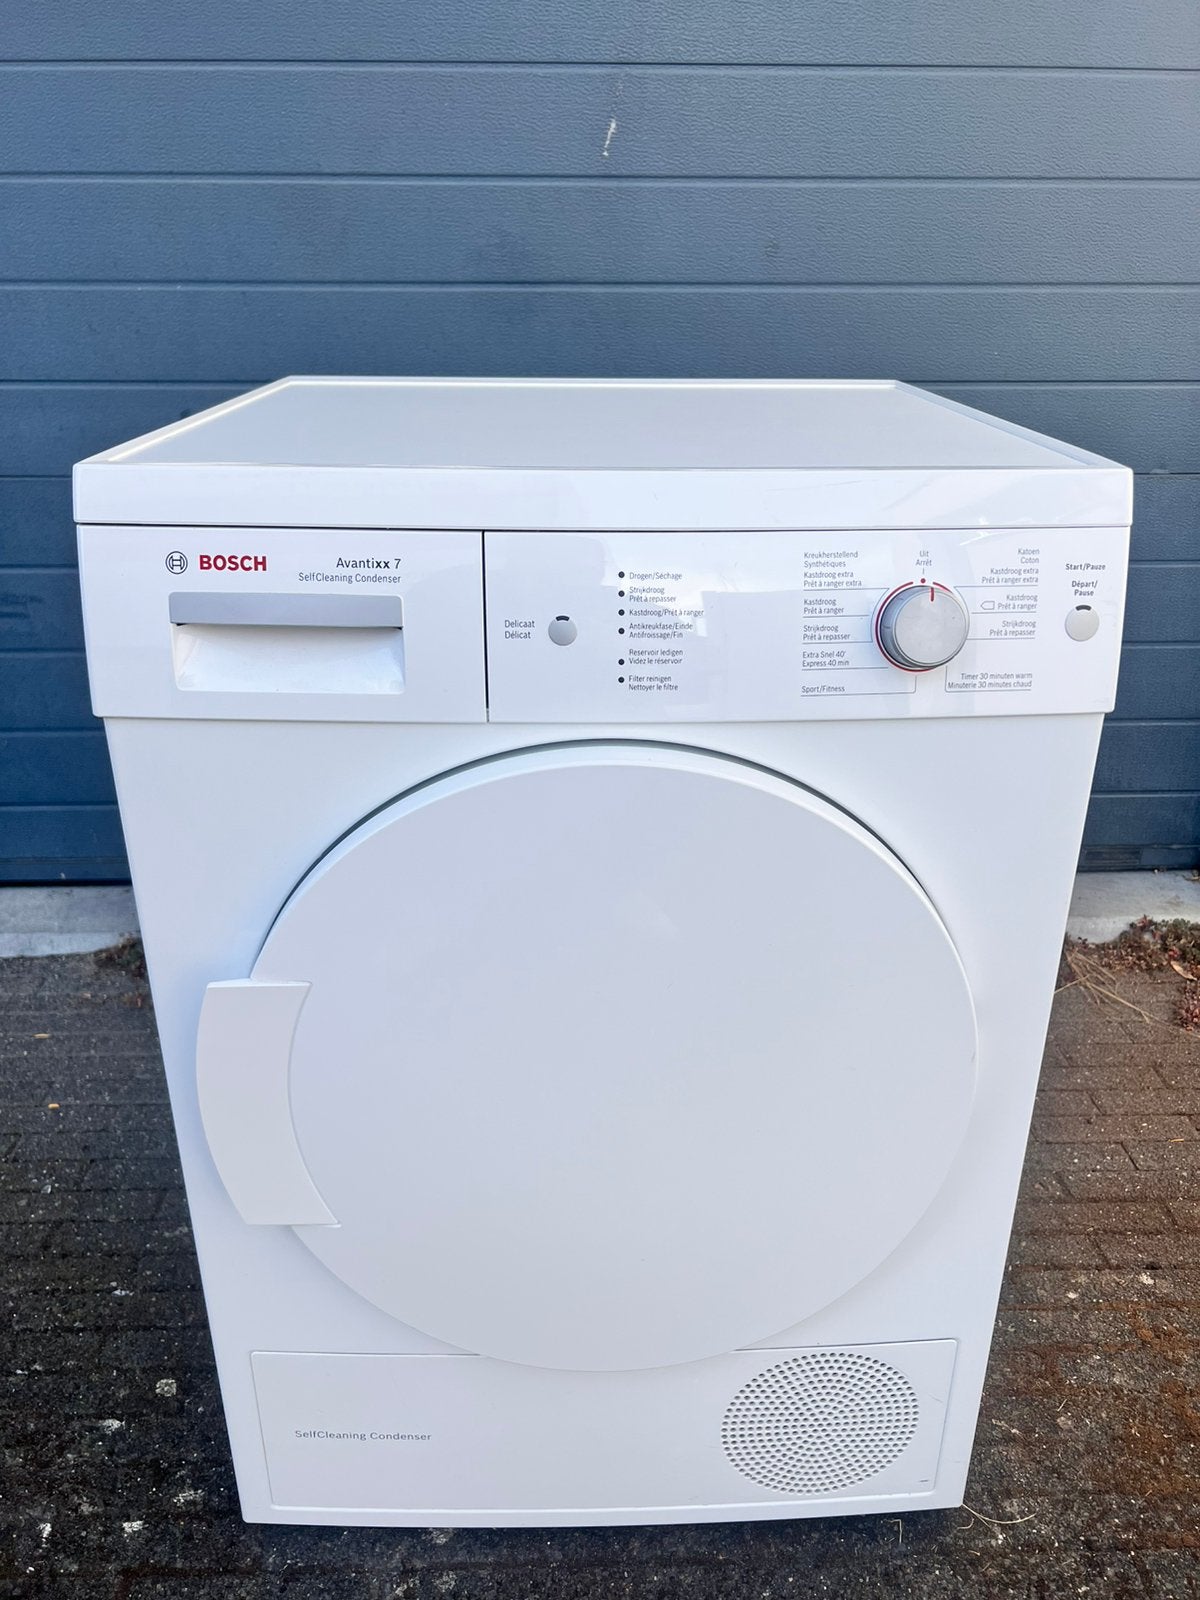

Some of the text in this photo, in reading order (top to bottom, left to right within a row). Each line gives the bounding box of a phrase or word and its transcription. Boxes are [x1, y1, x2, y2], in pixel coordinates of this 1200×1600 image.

[199, 555, 267, 571] BOSCH
[336, 557, 401, 569] Avantixx 7
[915, 558, 932, 566] Arrêt
[1020, 556, 1039, 564] Coton
[1065, 563, 1106, 571] Start/Pauze
[804, 571, 836, 579] Kastdroog
[990, 568, 1022, 576] Kastdroog
[298, 572, 401, 584] SelfCleaning Condenser
[981, 576, 995, 584] Prêt
[1002, 577, 1021, 585] ranger
[1072, 580, 1098, 589] Départ/
[629, 586, 665, 595] Strijkdroog
[629, 595, 642, 603] Prêt
[649, 596, 676, 604] repasser
[1006, 594, 1038, 602] Kastdroog
[804, 599, 836, 607] Kastdroog
[998, 602, 1011, 610] Prêt
[1018, 603, 1037, 611] ranger
[684, 609, 704, 617] ranger
[504, 619, 535, 628] Delicaat
[629, 622, 693, 631] Antikreukfase/Einde
[1002, 620, 1036, 628] Strijkdroog
[804, 625, 839, 633] Strijkdroog
[989, 628, 1003, 636] Prêt
[1009, 629, 1036, 637] repasser
[504, 630, 531, 639] Délicat
[629, 631, 683, 640] Antifroissage/Fin
[660, 649, 683, 657] ledigen
[629, 657, 683, 665] Videz le réservoir
[803, 660, 826, 668] Express
[646, 675, 672, 684] reinigen
[989, 672, 1014, 680] minuten
[629, 684, 655, 692] Nettoyer
[948, 681, 976, 689] Minuterie
[1013, 680, 1032, 688] chaud
[802, 685, 845, 693] Sport/Fitness
[295, 1430, 432, 1441] SelfCleaning Condenser
